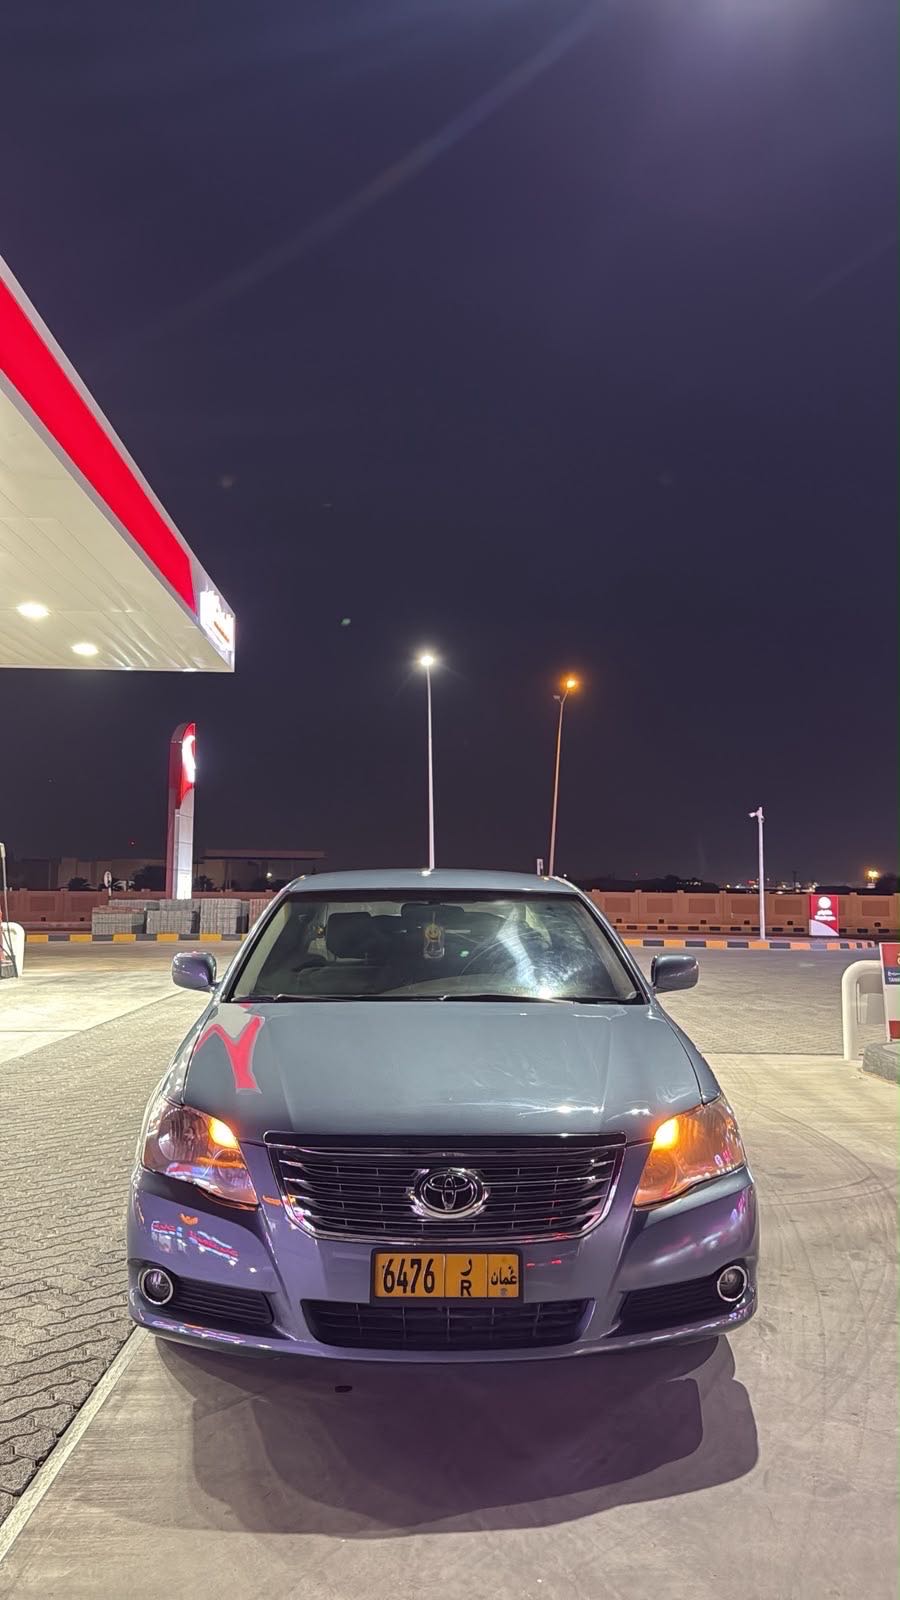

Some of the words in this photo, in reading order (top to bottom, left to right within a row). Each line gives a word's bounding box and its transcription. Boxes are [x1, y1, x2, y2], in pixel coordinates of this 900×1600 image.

[383, 1258, 435, 1294] 6476
[460, 1258, 472, 1276] ر
[460, 1279, 472, 1297] R
